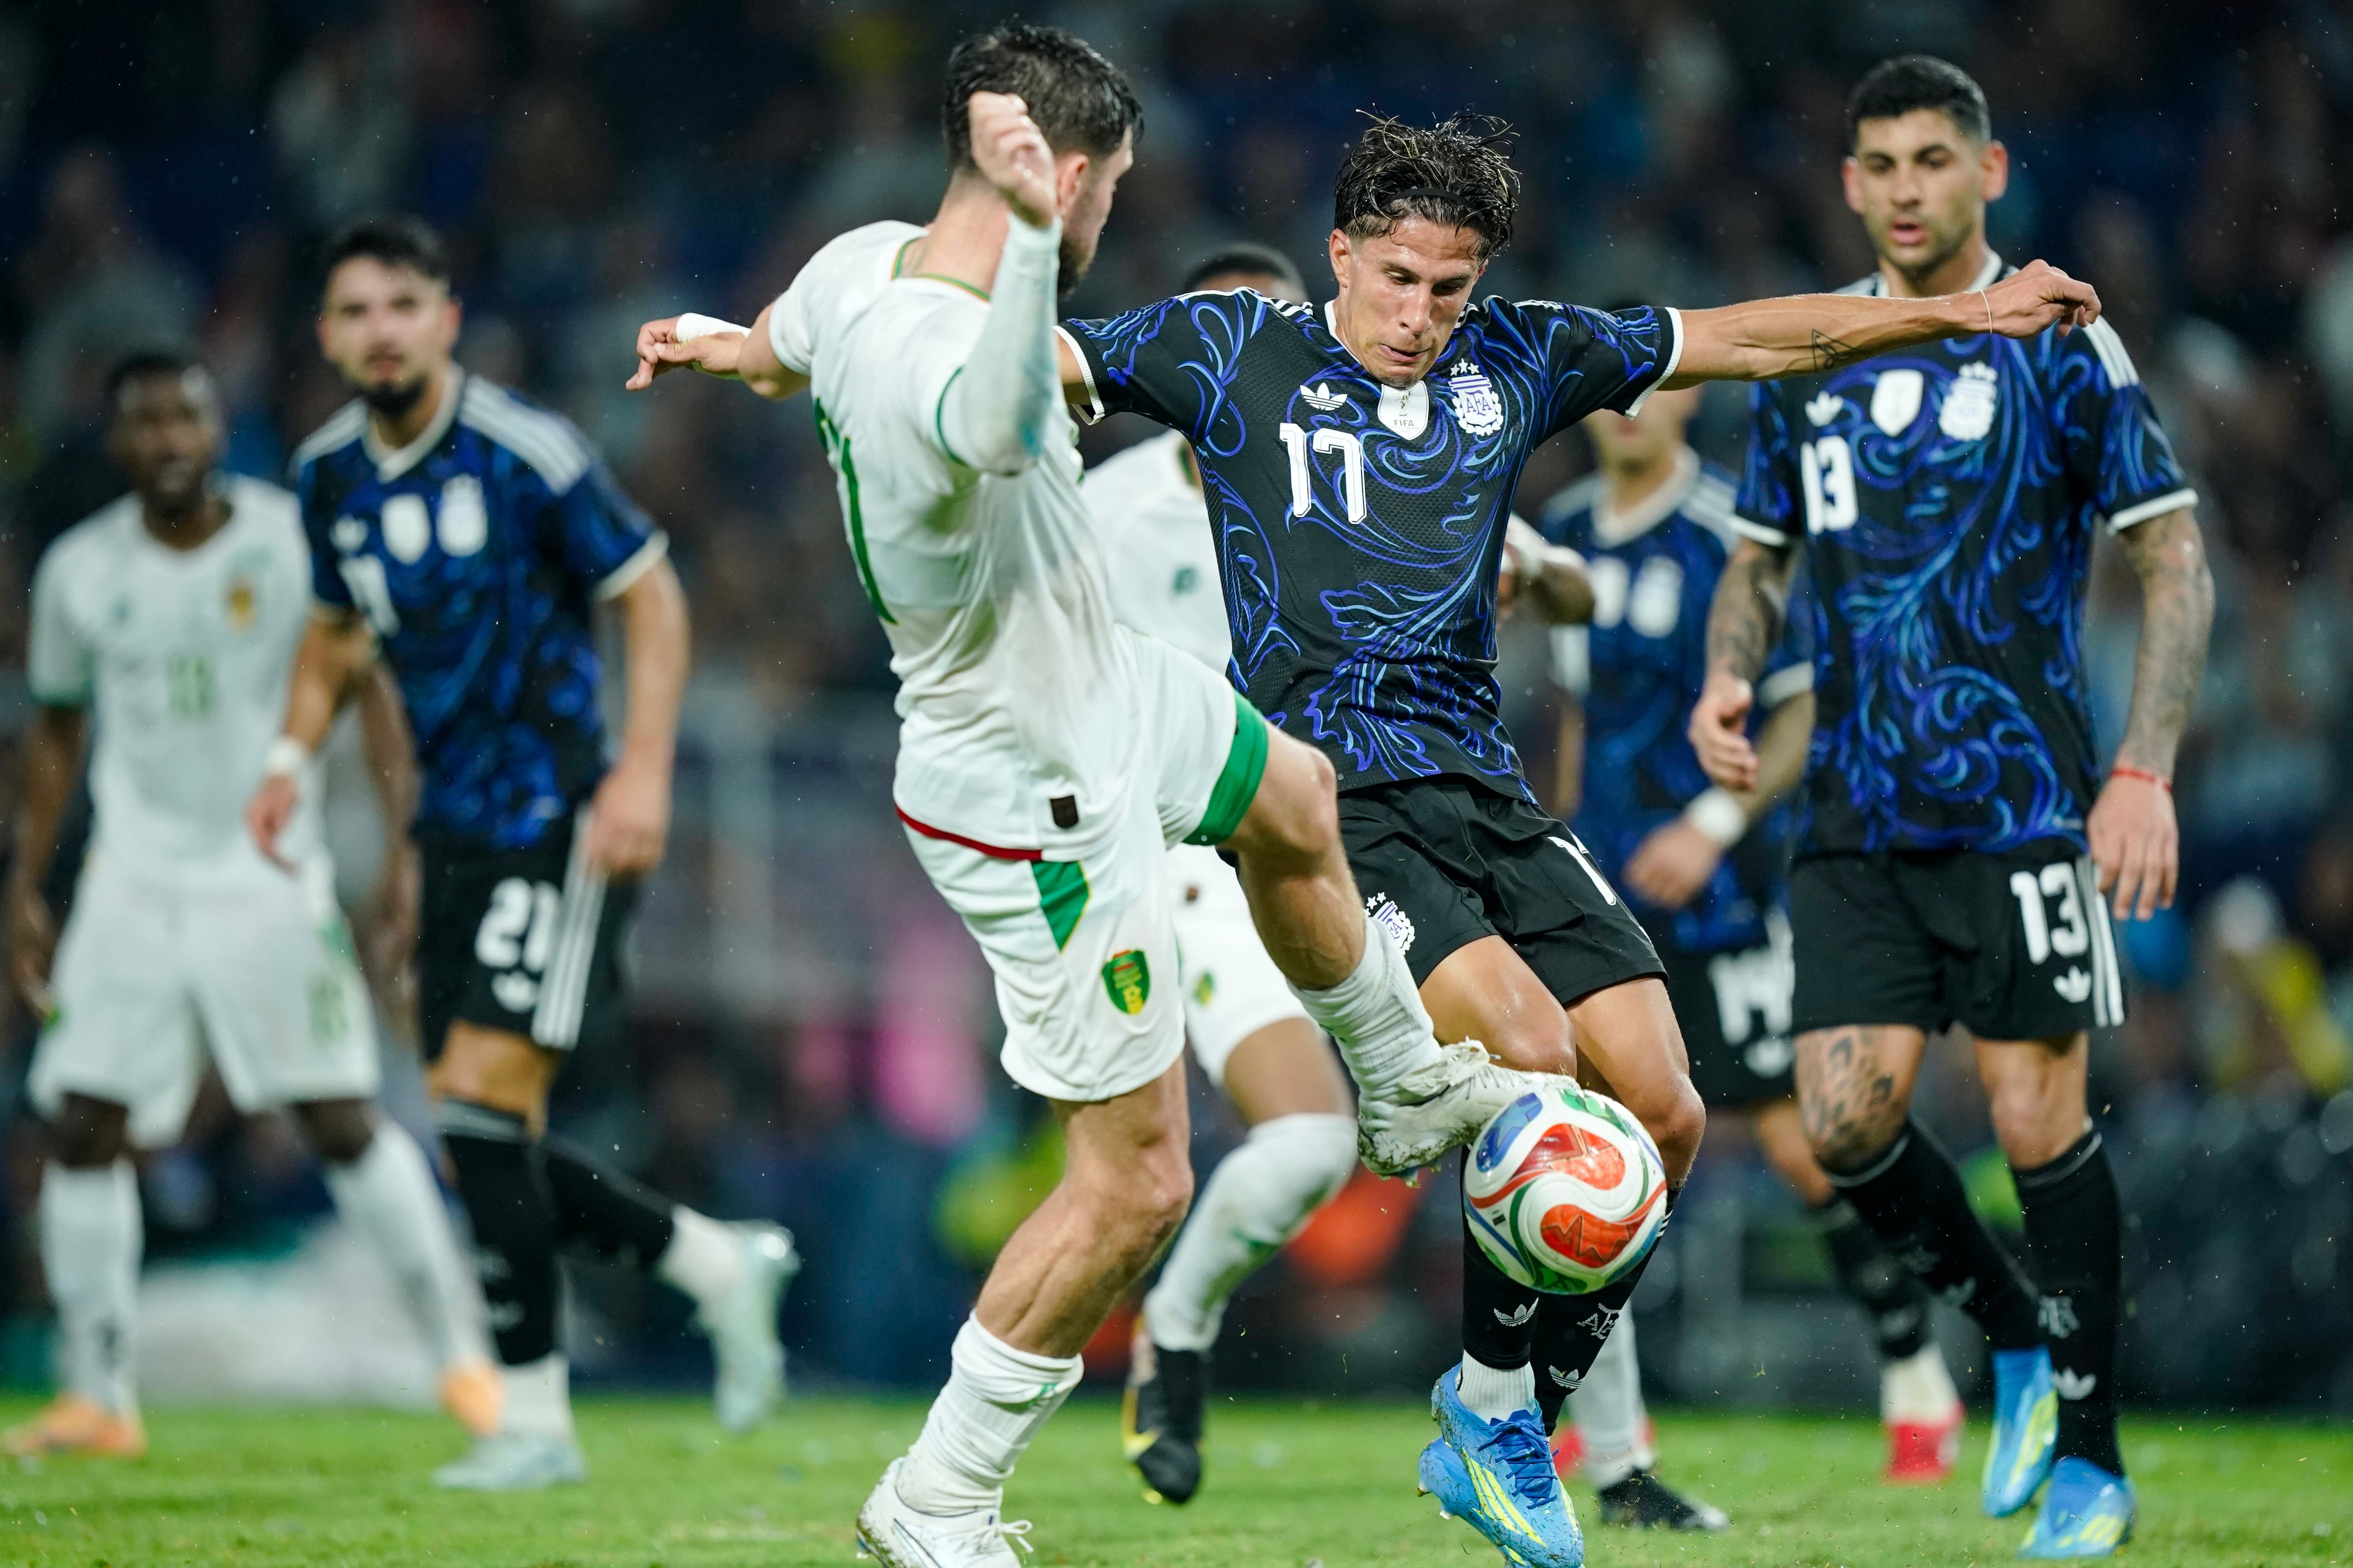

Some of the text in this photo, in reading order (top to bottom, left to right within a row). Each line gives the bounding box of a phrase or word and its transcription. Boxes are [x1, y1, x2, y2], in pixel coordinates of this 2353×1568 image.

[1465, 390, 1492, 416] AFA
[1279, 423, 1367, 525] 17
[1800, 434, 1859, 536] 13
[474, 876, 559, 973] 21
[2009, 861, 2089, 965] 13
